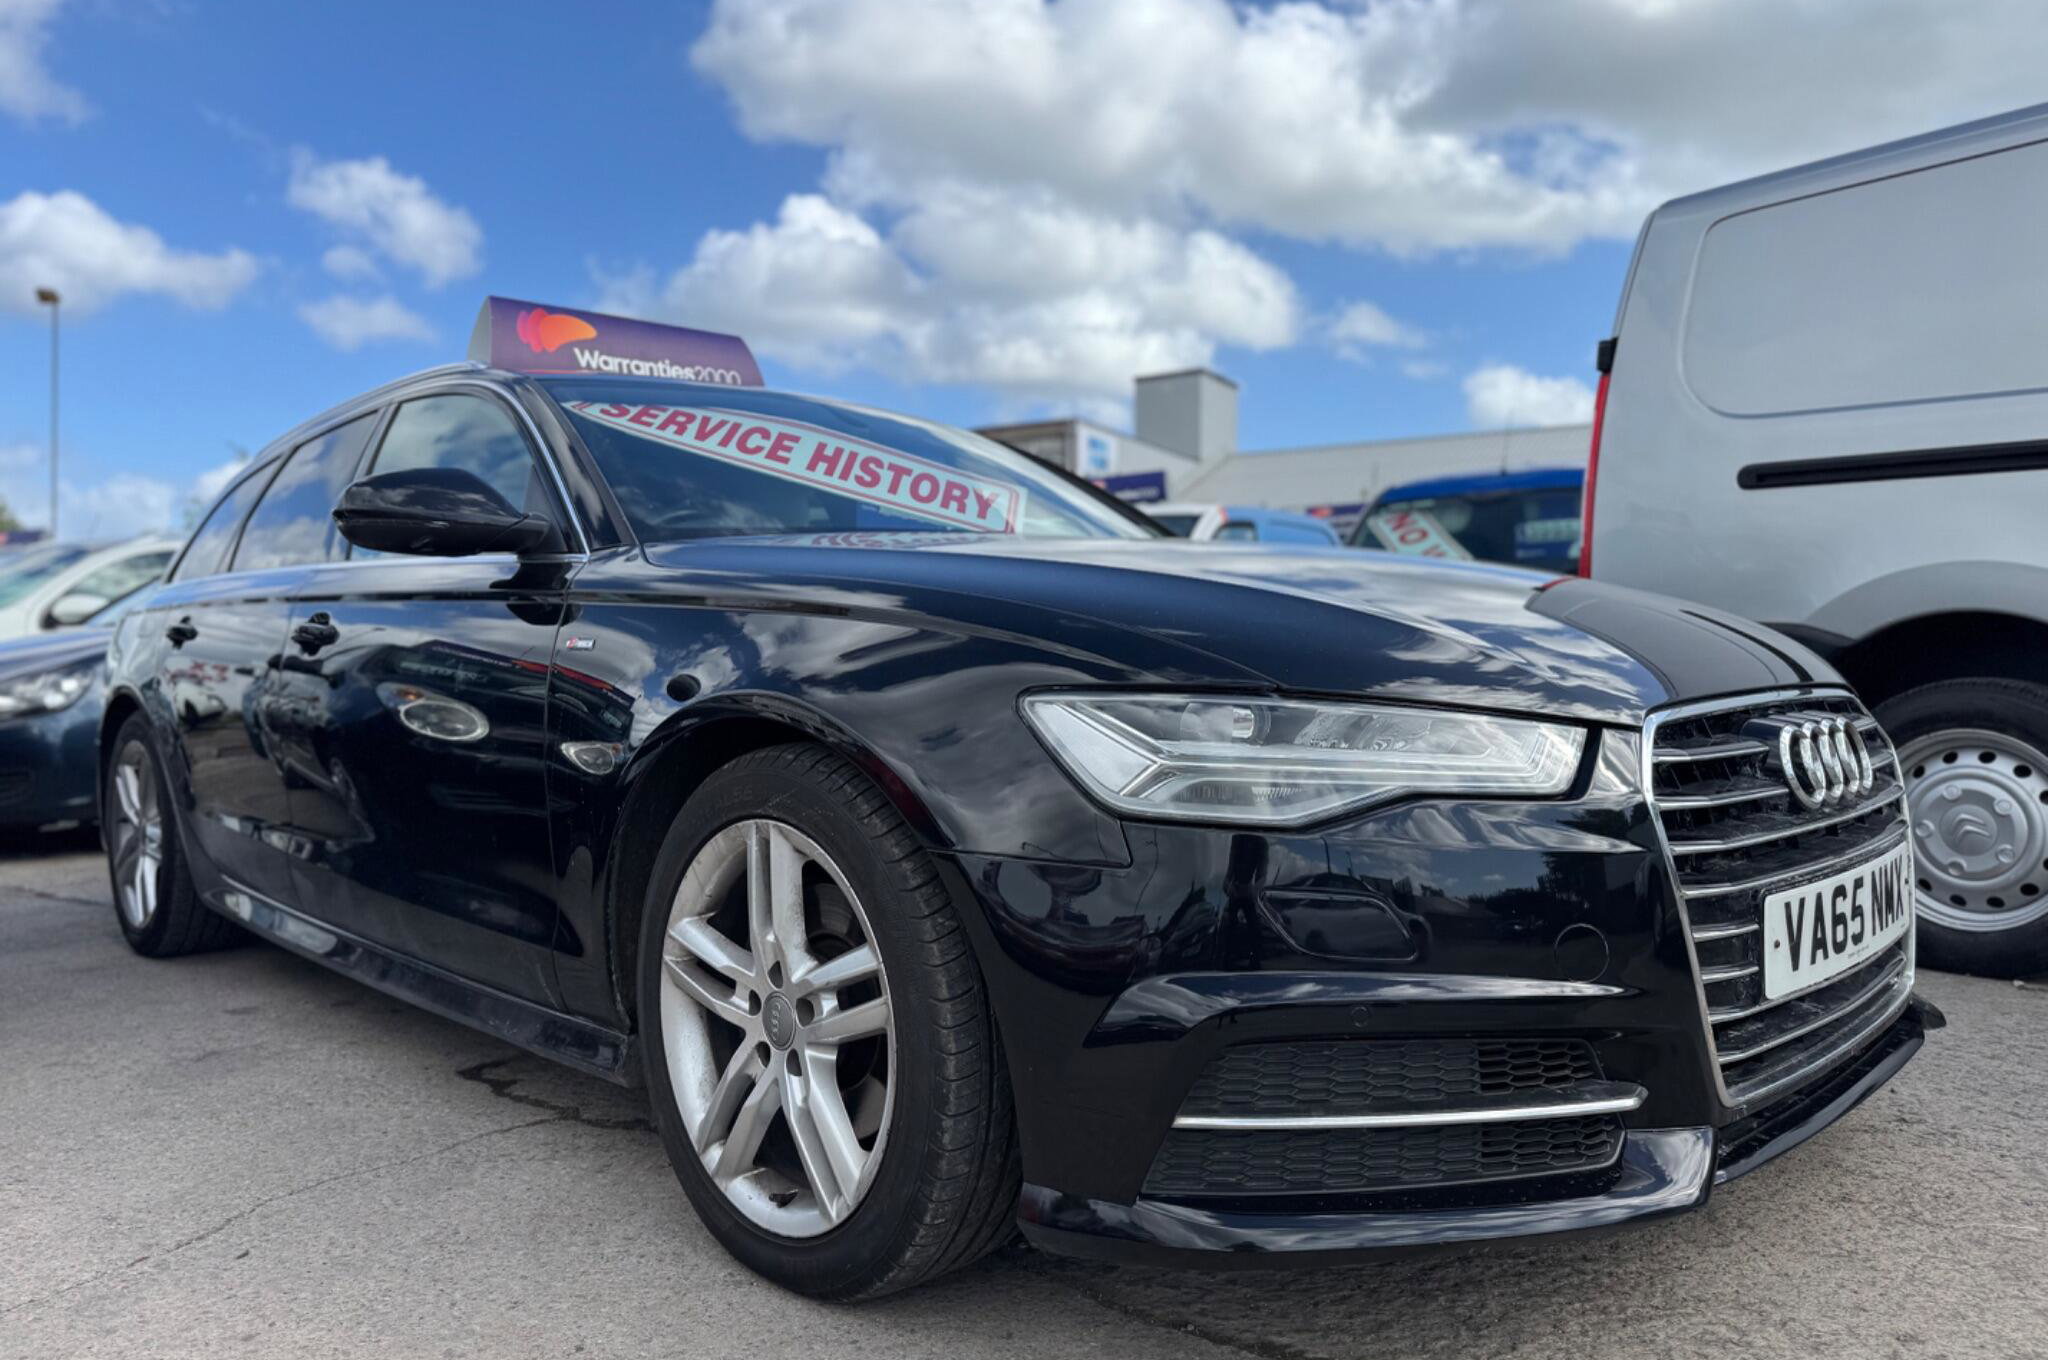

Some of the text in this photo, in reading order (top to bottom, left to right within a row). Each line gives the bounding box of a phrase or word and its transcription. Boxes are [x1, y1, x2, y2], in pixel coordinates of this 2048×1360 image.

[573, 347, 742, 386] Warranties2000
[600, 402, 999, 520] SERVICE HISTORY
[1784, 854, 1904, 972] VA65 NMX
